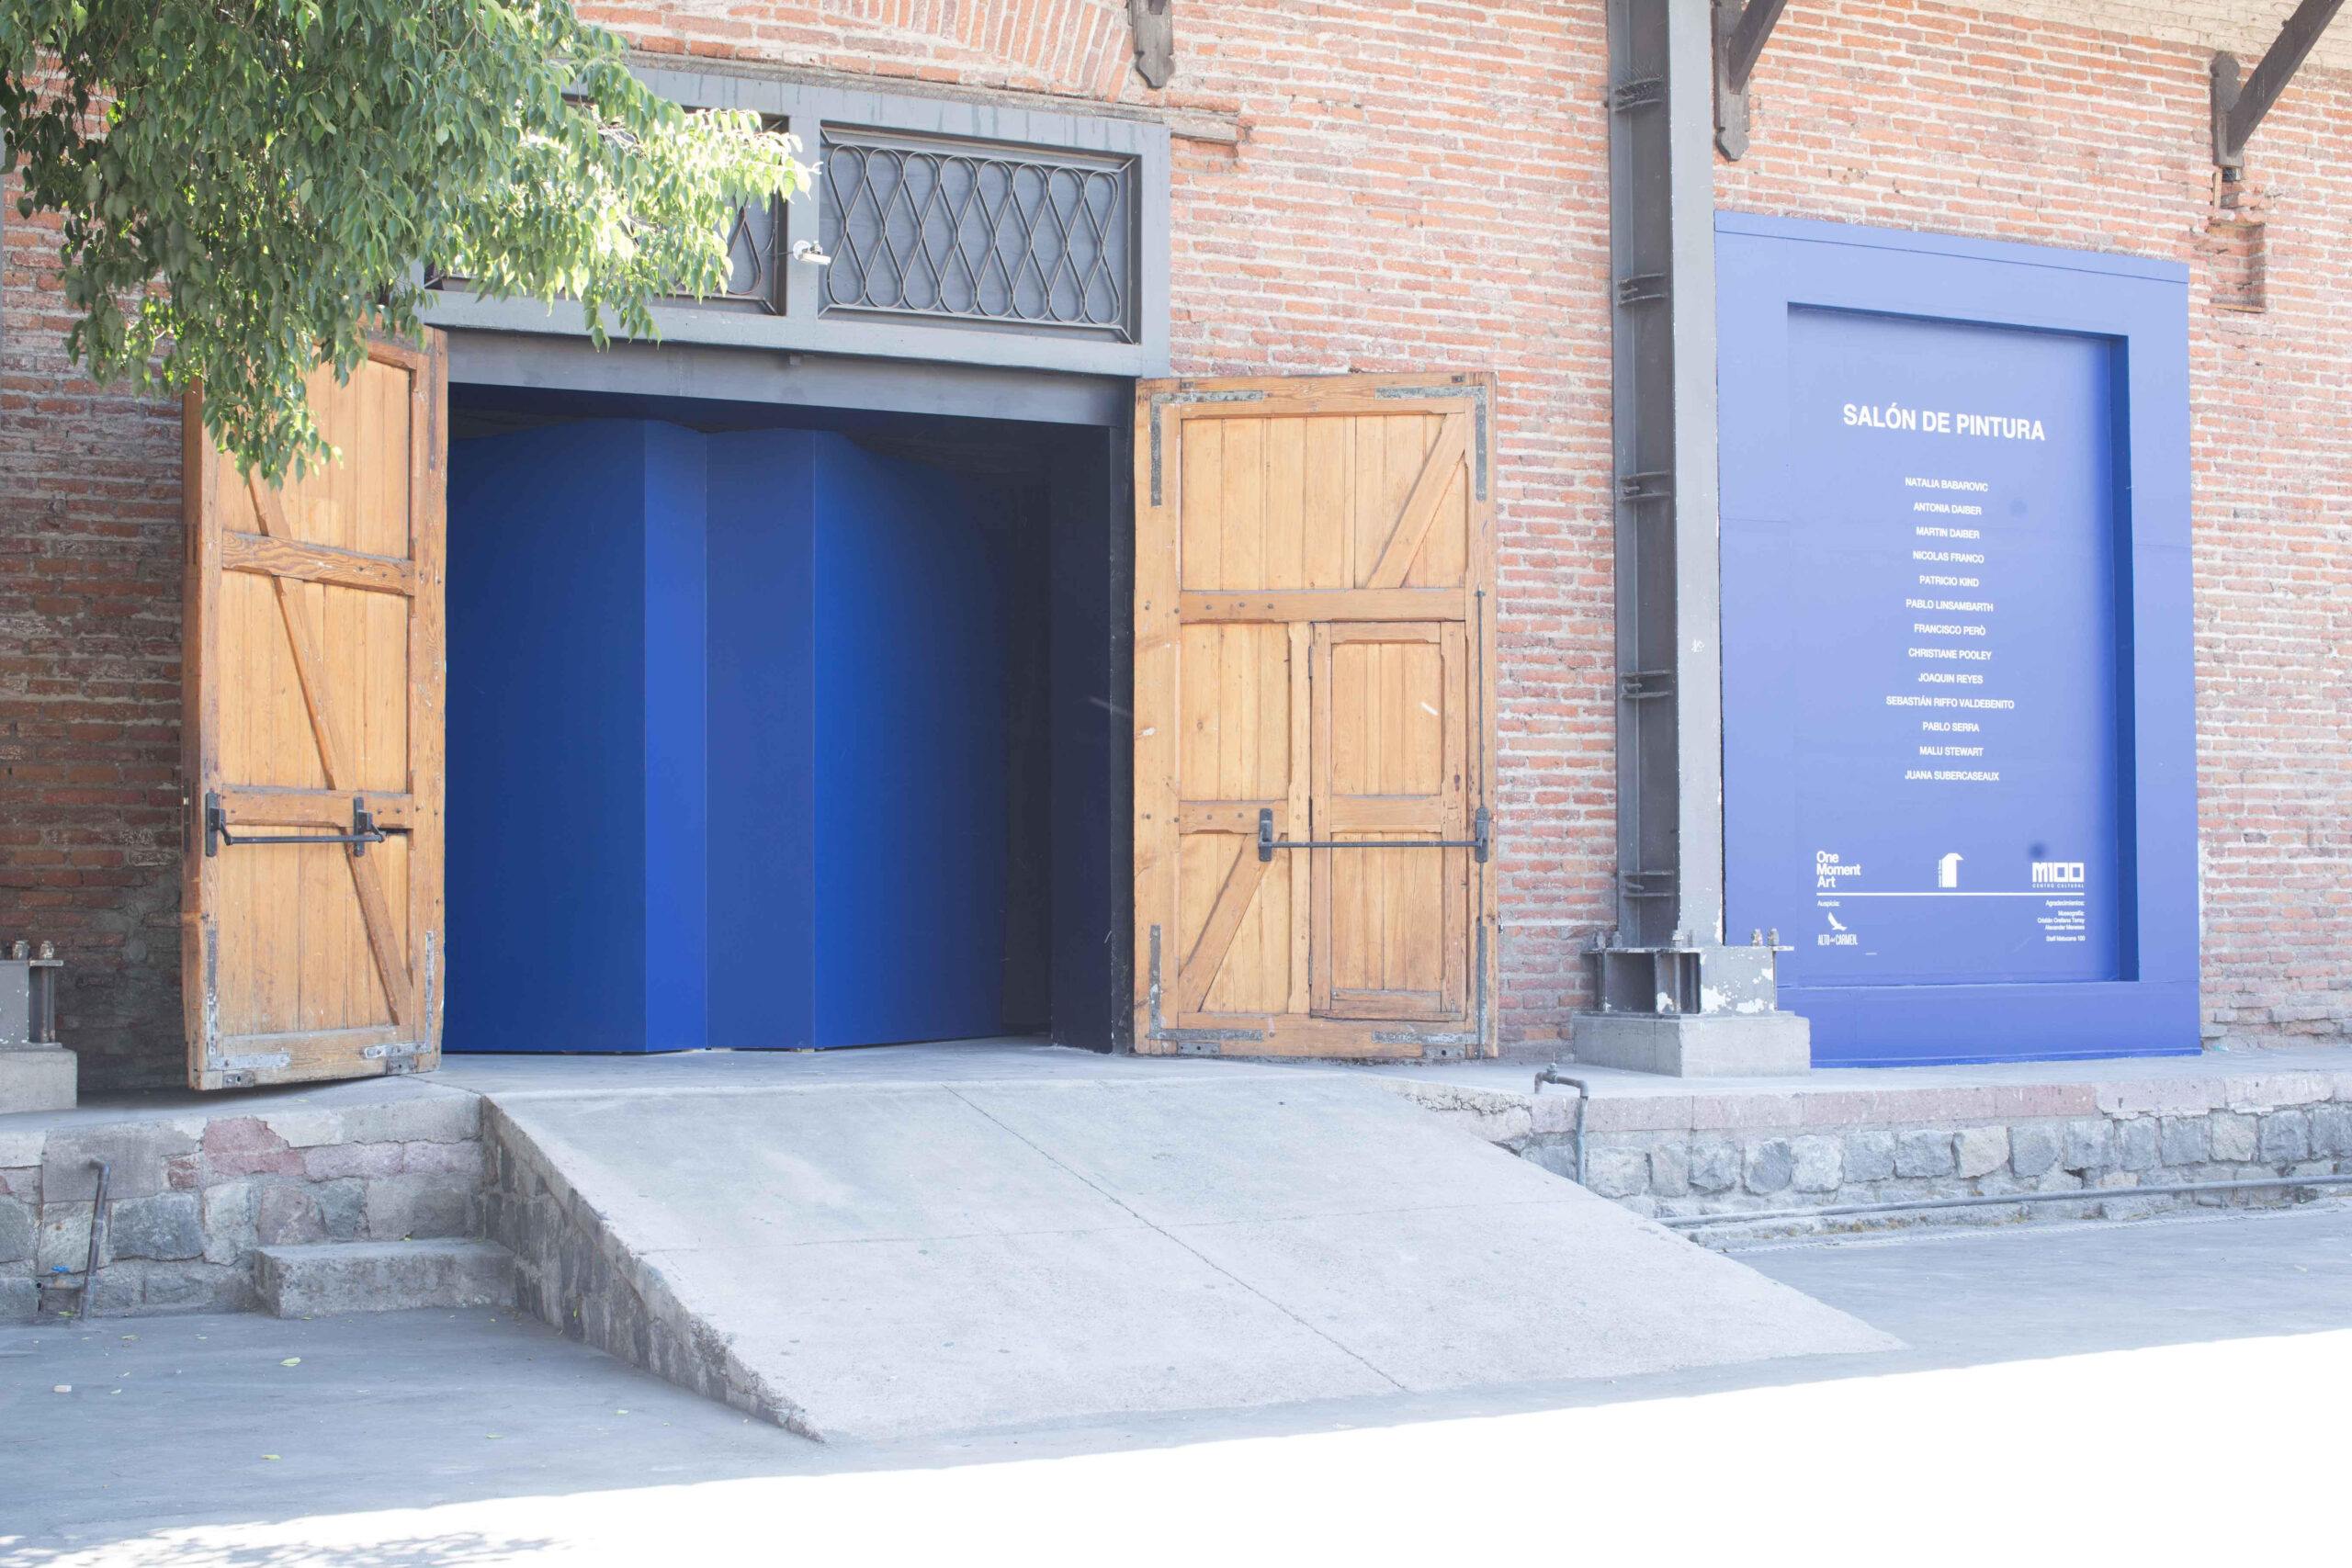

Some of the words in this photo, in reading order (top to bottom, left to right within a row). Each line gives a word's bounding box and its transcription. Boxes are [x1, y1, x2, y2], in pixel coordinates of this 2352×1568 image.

[1844, 402, 1916, 430] SALÓN
[1923, 411, 1951, 433] DE
[1957, 414, 2045, 441] PINTURA
[1905, 478, 1939, 488] NATALIA
[1941, 480, 1988, 491] BABAROVIC
[1914, 502, 1950, 513] ANTONIA
[1951, 505, 1982, 514] DAIBER
[1917, 526, 1948, 536] MARTIN
[1950, 529, 1979, 538] DAIBER
[1913, 551, 1949, 561] NICOLAS
[1951, 553, 1984, 563] FRANCO
[1920, 575, 1957, 585] PATRICIO
[1960, 578, 1979, 587] KIND
[1906, 599, 1934, 608] PABLO
[1936, 601, 1993, 612] LINSAMBARTH
[1915, 624, 1962, 634] FRANCISCO
[1908, 648, 1957, 659] CHRISTIANE
[1960, 650, 1992, 660] POOLEY
[1918, 673, 1954, 682] JOAQUIN
[1957, 674, 1983, 683] REYES
[1886, 695, 1932, 705] SEBASTIÁN
[1934, 698, 1958, 706] RIFFO
[1960, 699, 2015, 709] VALDEBENITO
[1923, 722, 1951, 731] PABLO
[1952, 723, 1979, 731] SERRA
[1920, 747, 1942, 755] MALU
[1945, 747, 1984, 756] STEWART
[1905, 771, 1932, 779] JUANA
[1934, 771, 1999, 781] SUBERCASEAUX
[1816, 851, 1839, 863] One
[1816, 863, 1861, 875] Moment
[1817, 875, 1836, 887] Art
[1818, 934, 1830, 945] ALTO
